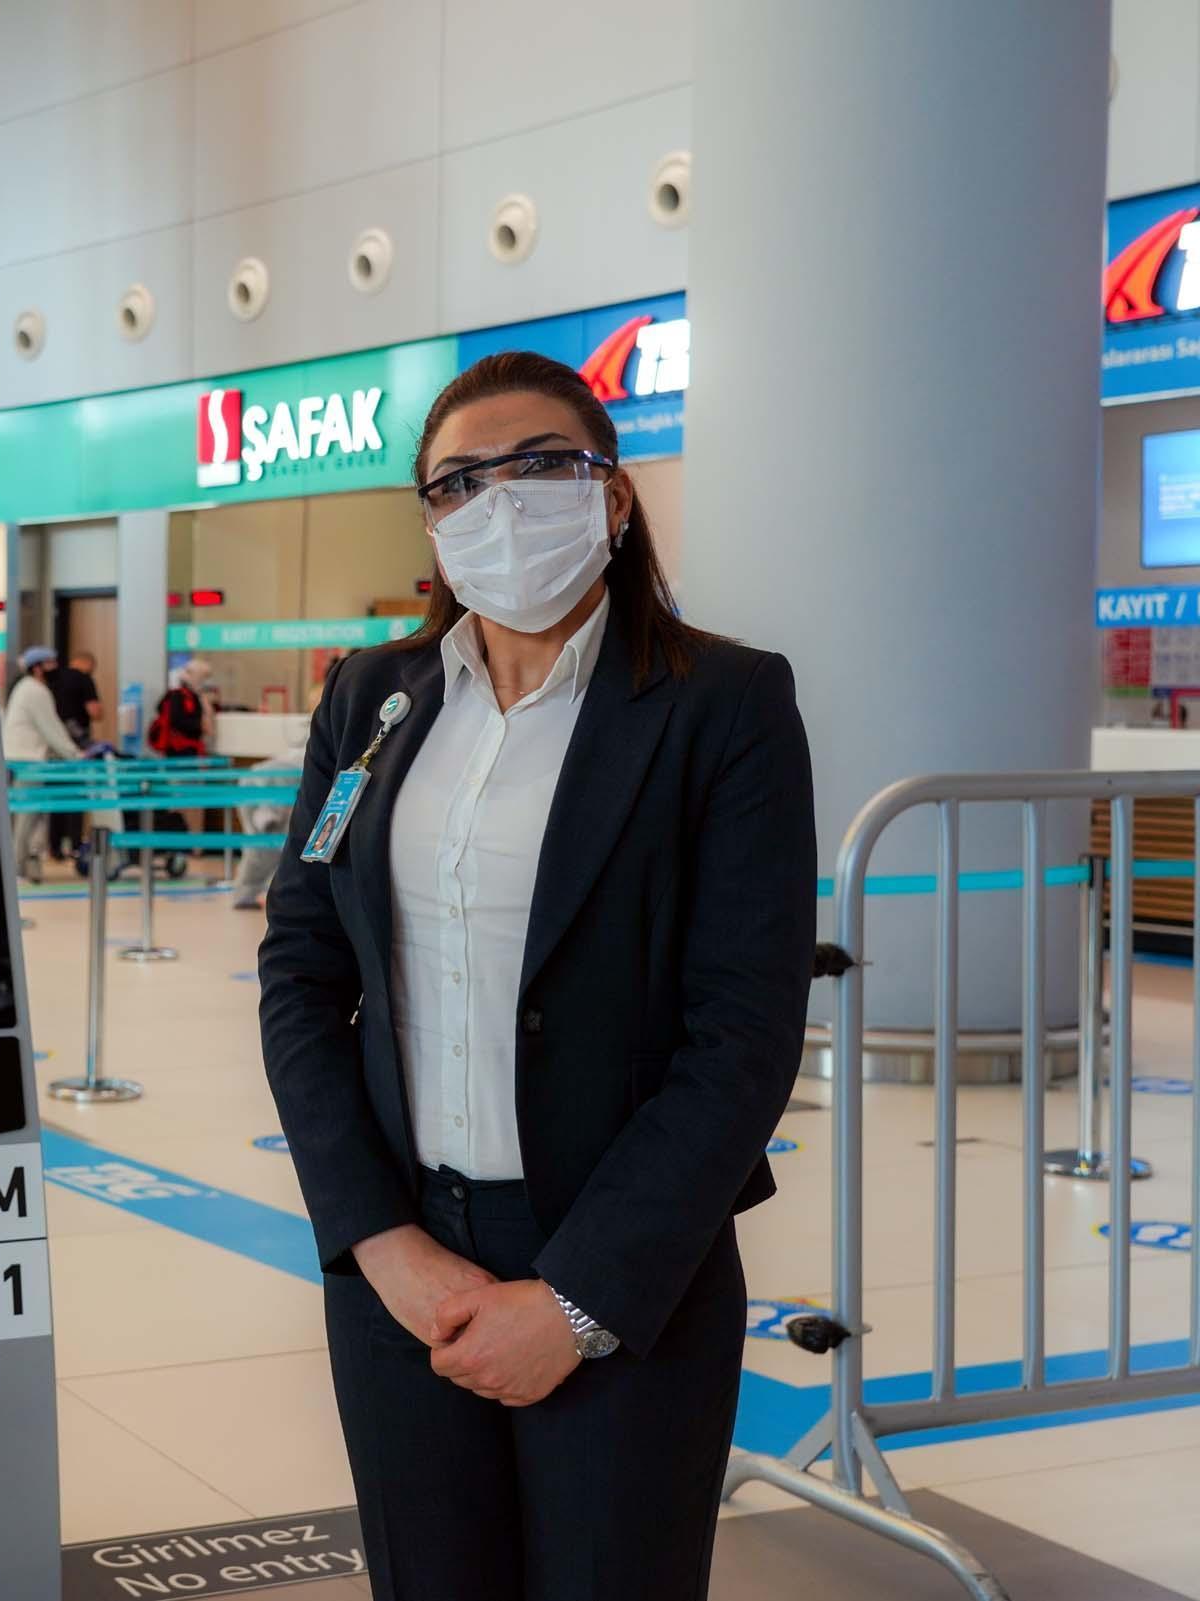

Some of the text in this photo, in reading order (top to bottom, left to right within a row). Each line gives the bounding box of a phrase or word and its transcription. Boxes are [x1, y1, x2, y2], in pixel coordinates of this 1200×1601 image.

[241, 387, 383, 482] ŞAFAK
[1098, 595, 1168, 621] KAYIT
[3, 1263, 24, 1316] 1
[92, 1524, 330, 1568] Girilmez
[114, 1547, 366, 1598] No entry
